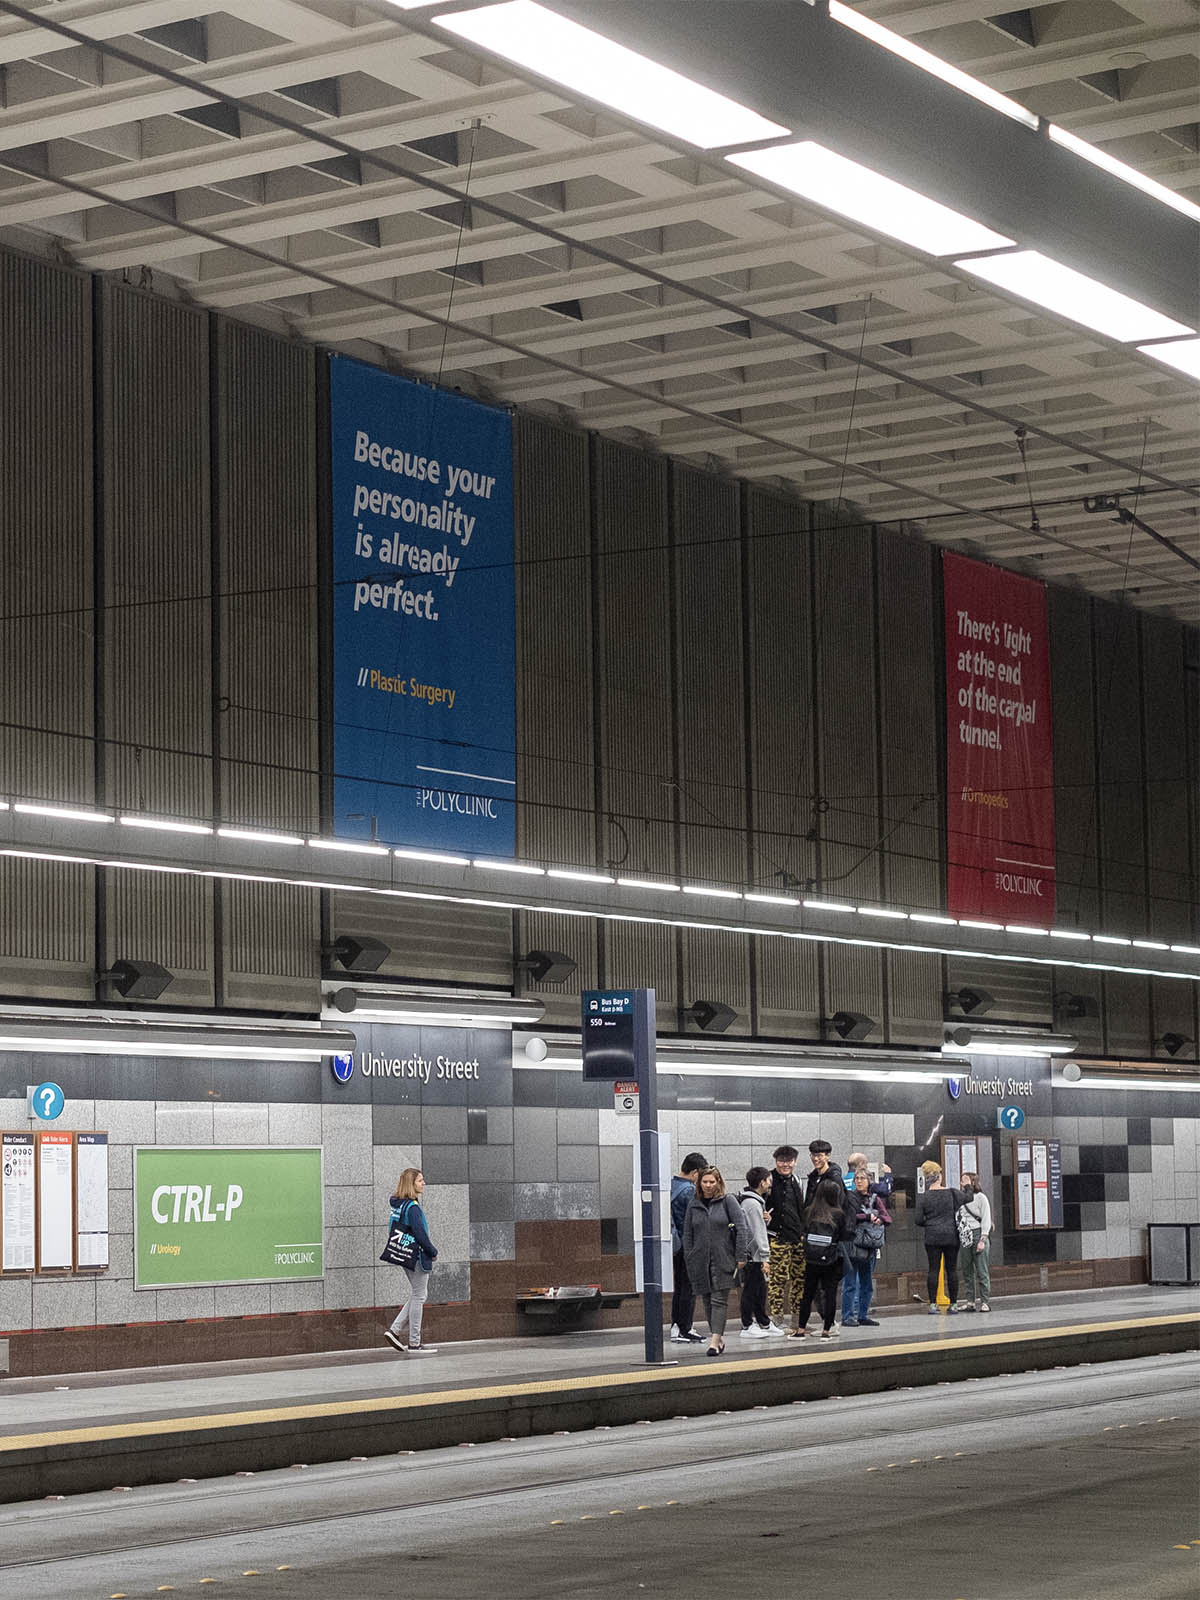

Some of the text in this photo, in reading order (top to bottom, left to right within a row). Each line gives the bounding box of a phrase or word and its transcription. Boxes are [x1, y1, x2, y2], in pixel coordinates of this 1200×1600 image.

[354, 430, 496, 499] Because your
[353, 484, 476, 546] personality
[355, 523, 460, 588] is already
[354, 580, 439, 621] perfect.
[956, 610, 1031, 657] There's light
[957, 650, 1022, 686] at the end
[410, 677, 456, 709] Surgery
[958, 683, 1036, 727] of the carpal
[959, 719, 1002, 751] tunnel.
[422, 787, 498, 819] POLYCLINIC
[601, 997, 630, 1007] Bus Bay D
[590, 1018, 603, 1027] 550
[361, 1052, 480, 1084] University Street
[965, 1076, 1033, 1100] University Street
[151, 1184, 243, 1224] CTRL-P
[277, 1252, 315, 1264] POLYCLINIC
